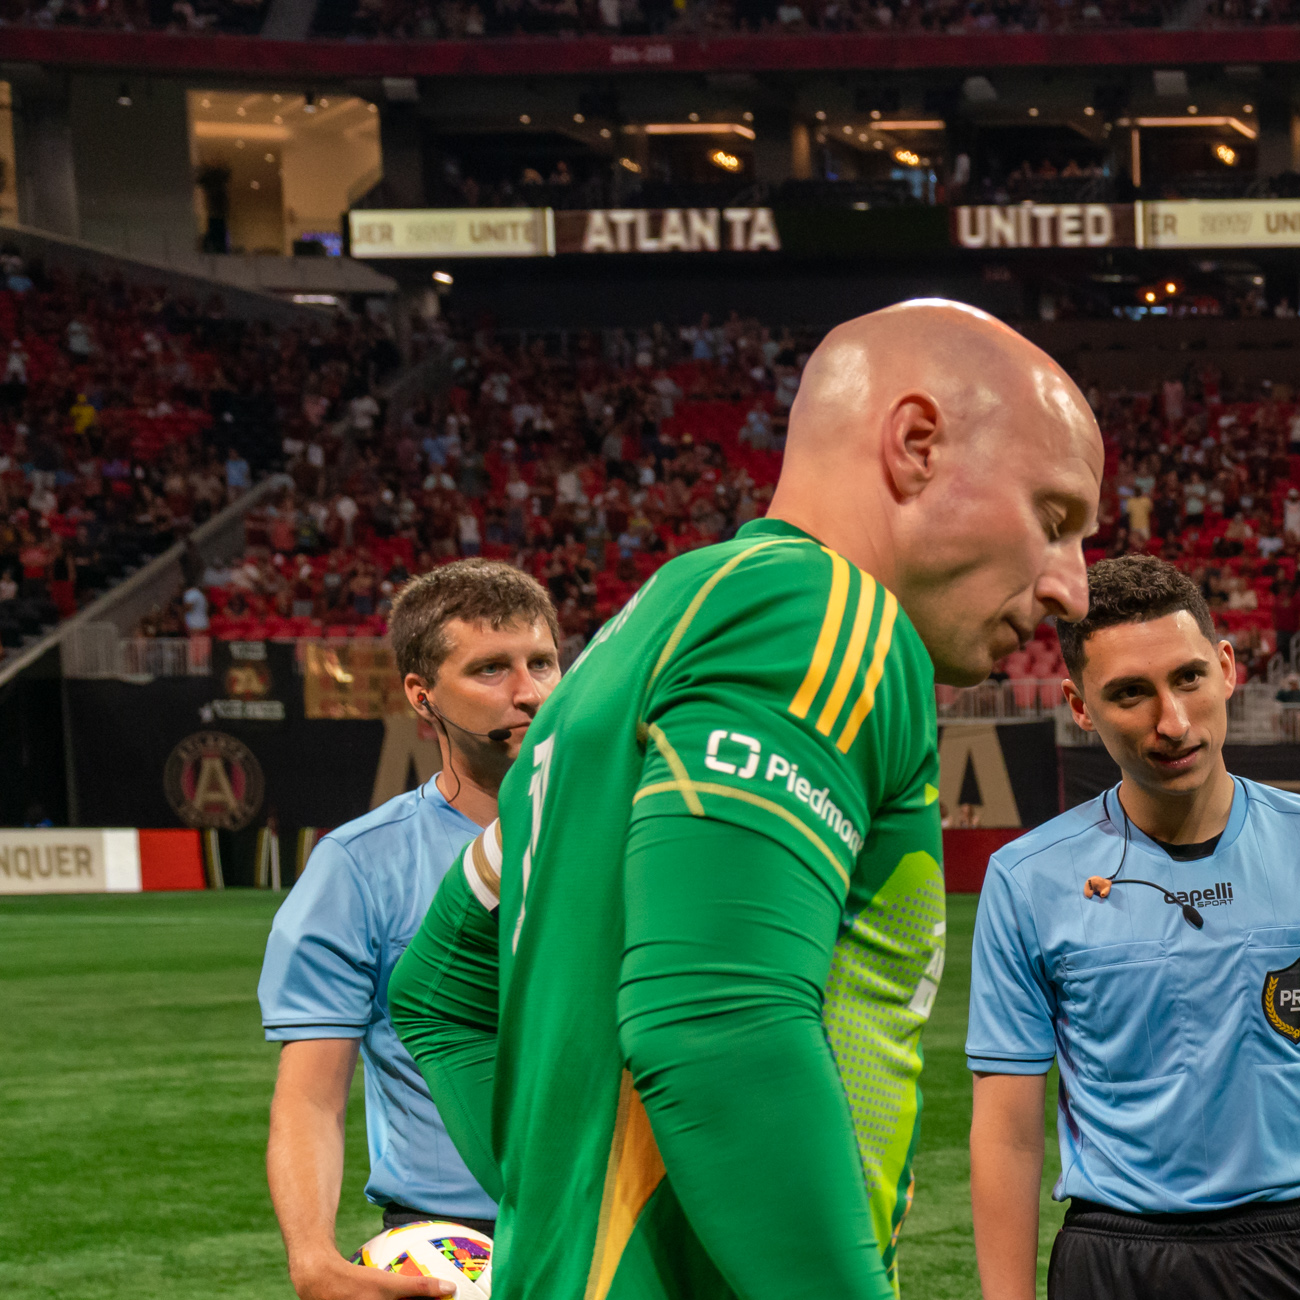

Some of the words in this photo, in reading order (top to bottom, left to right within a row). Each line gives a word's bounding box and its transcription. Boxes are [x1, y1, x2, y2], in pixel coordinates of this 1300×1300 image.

[583, 208, 781, 253] ATLANTA
[957, 204, 1114, 249] UNITED
[1164, 882, 1234, 907] capelli
[1197, 898, 1234, 908] SPORT
